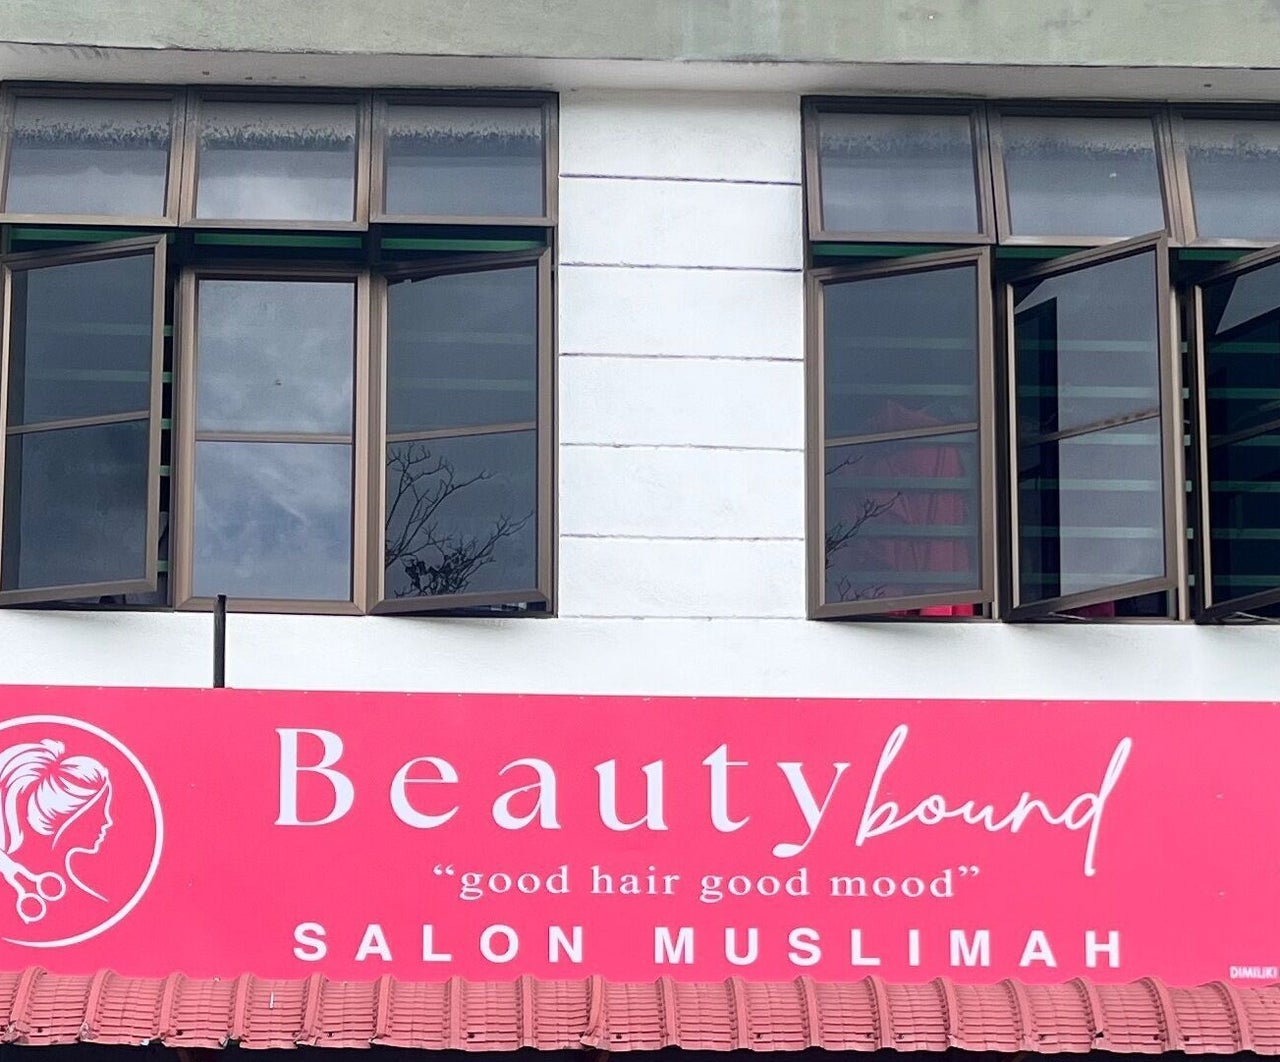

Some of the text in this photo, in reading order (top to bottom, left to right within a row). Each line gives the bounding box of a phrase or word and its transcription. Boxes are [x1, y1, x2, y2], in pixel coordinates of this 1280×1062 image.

[590, 864, 681, 895] hair
[699, 867, 810, 904] good
[293, 921, 1121, 969] SALON MUSLIMAH
[1228, 965, 1278, 980] DIMILIKI
